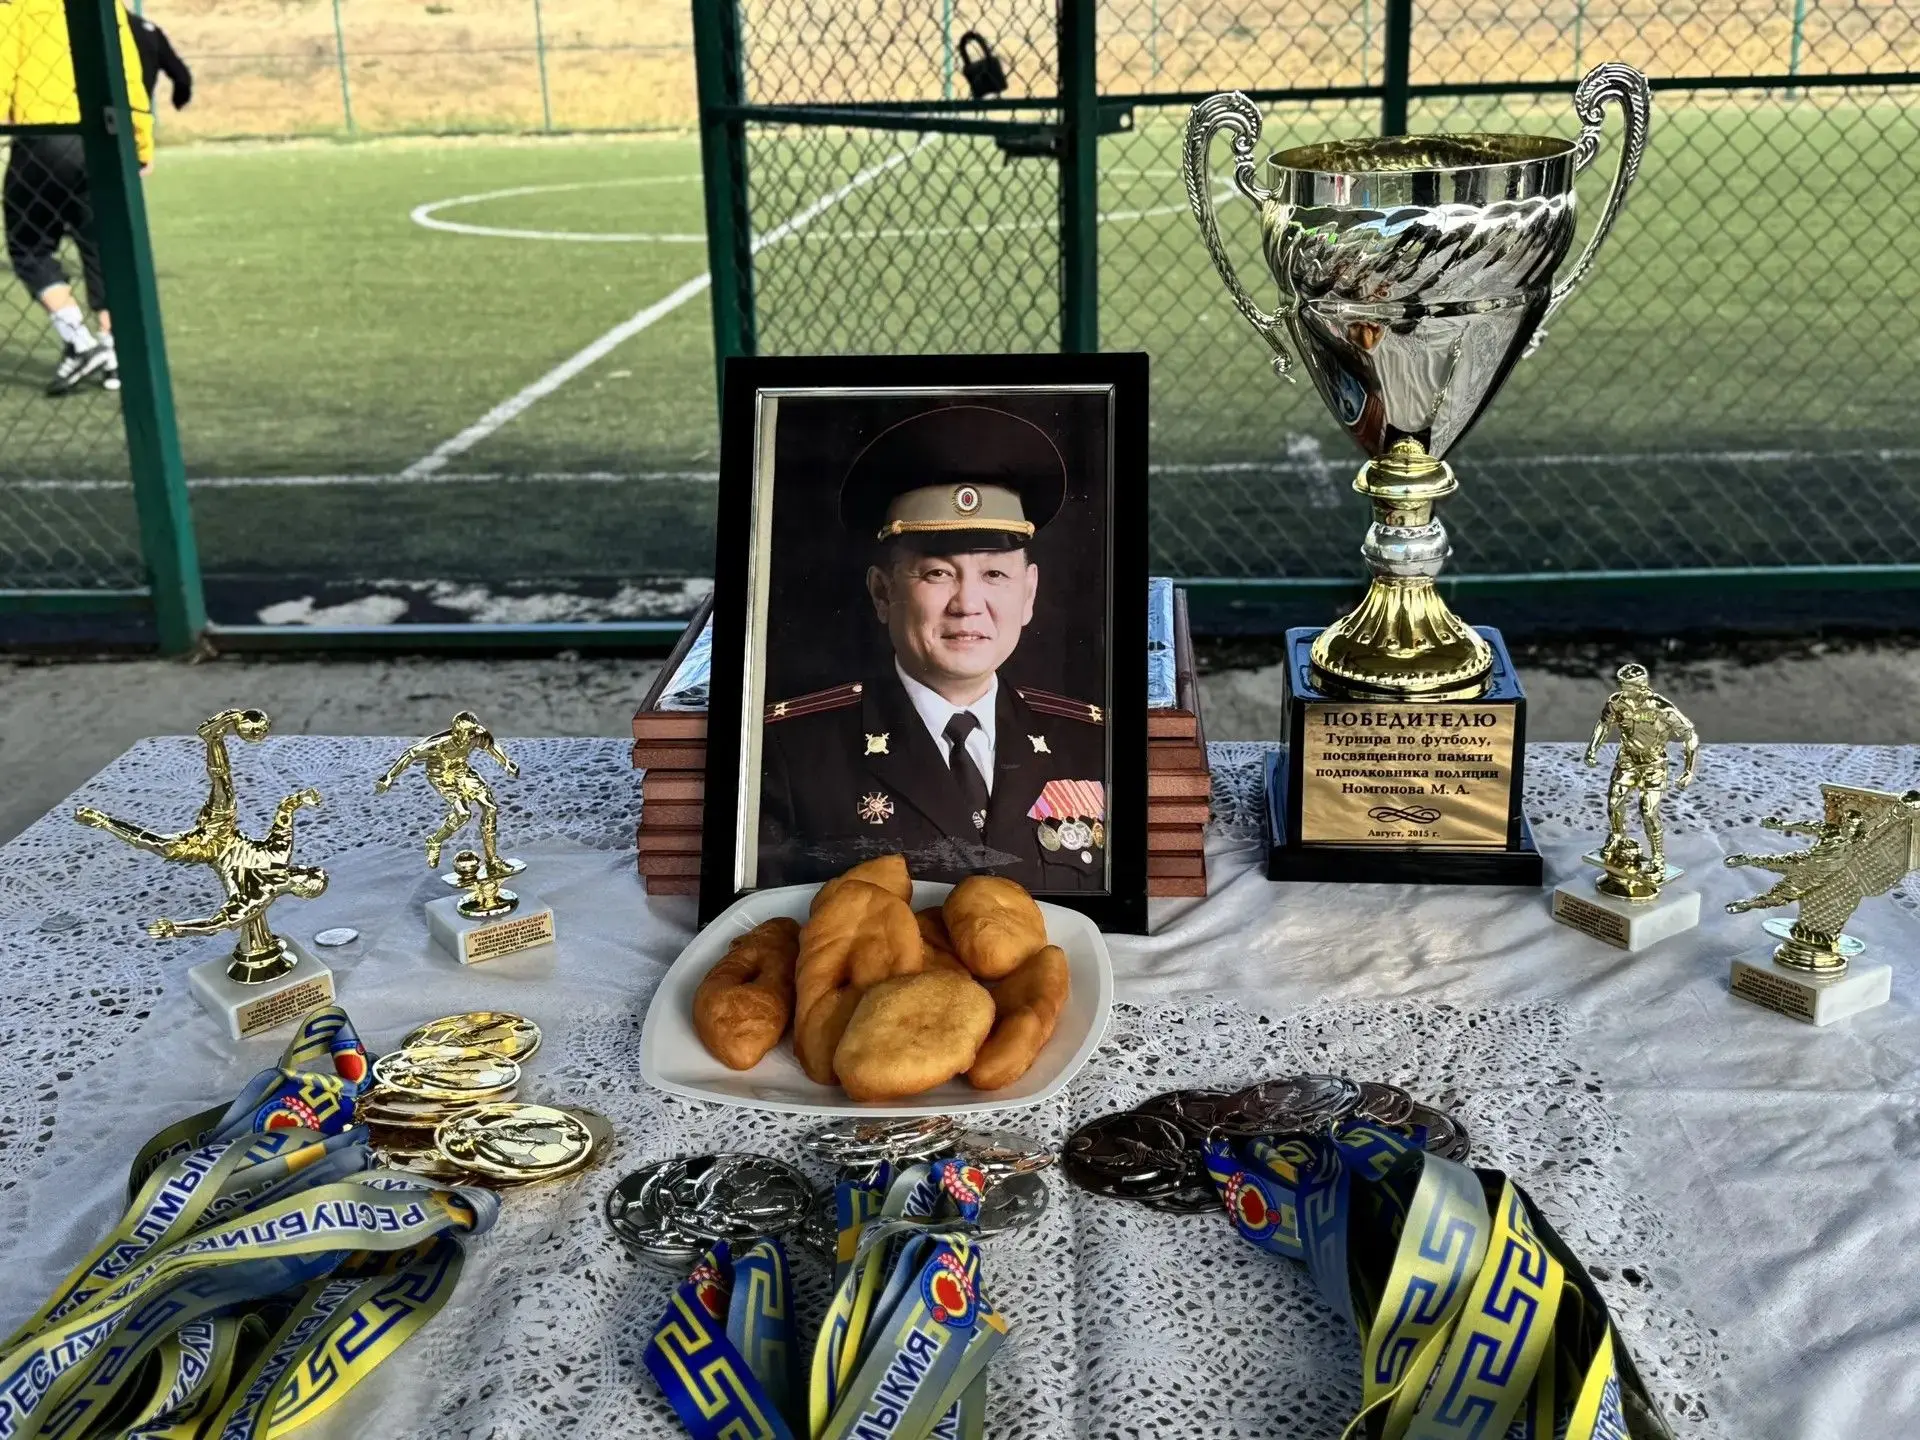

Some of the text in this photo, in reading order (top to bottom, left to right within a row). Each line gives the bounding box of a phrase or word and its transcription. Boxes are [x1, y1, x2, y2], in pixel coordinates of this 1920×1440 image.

[1323, 712, 1497, 729] ПОБЕДИТЕЛЮ
[1326, 732, 1491, 747] Турнира по футболу,
[1323, 751, 1493, 763] посвященного памяти
[1316, 768, 1499, 780] подполковника полиции
[1341, 783, 1471, 795] Номгонова М. А.
[1367, 829, 1404, 838] Август,
